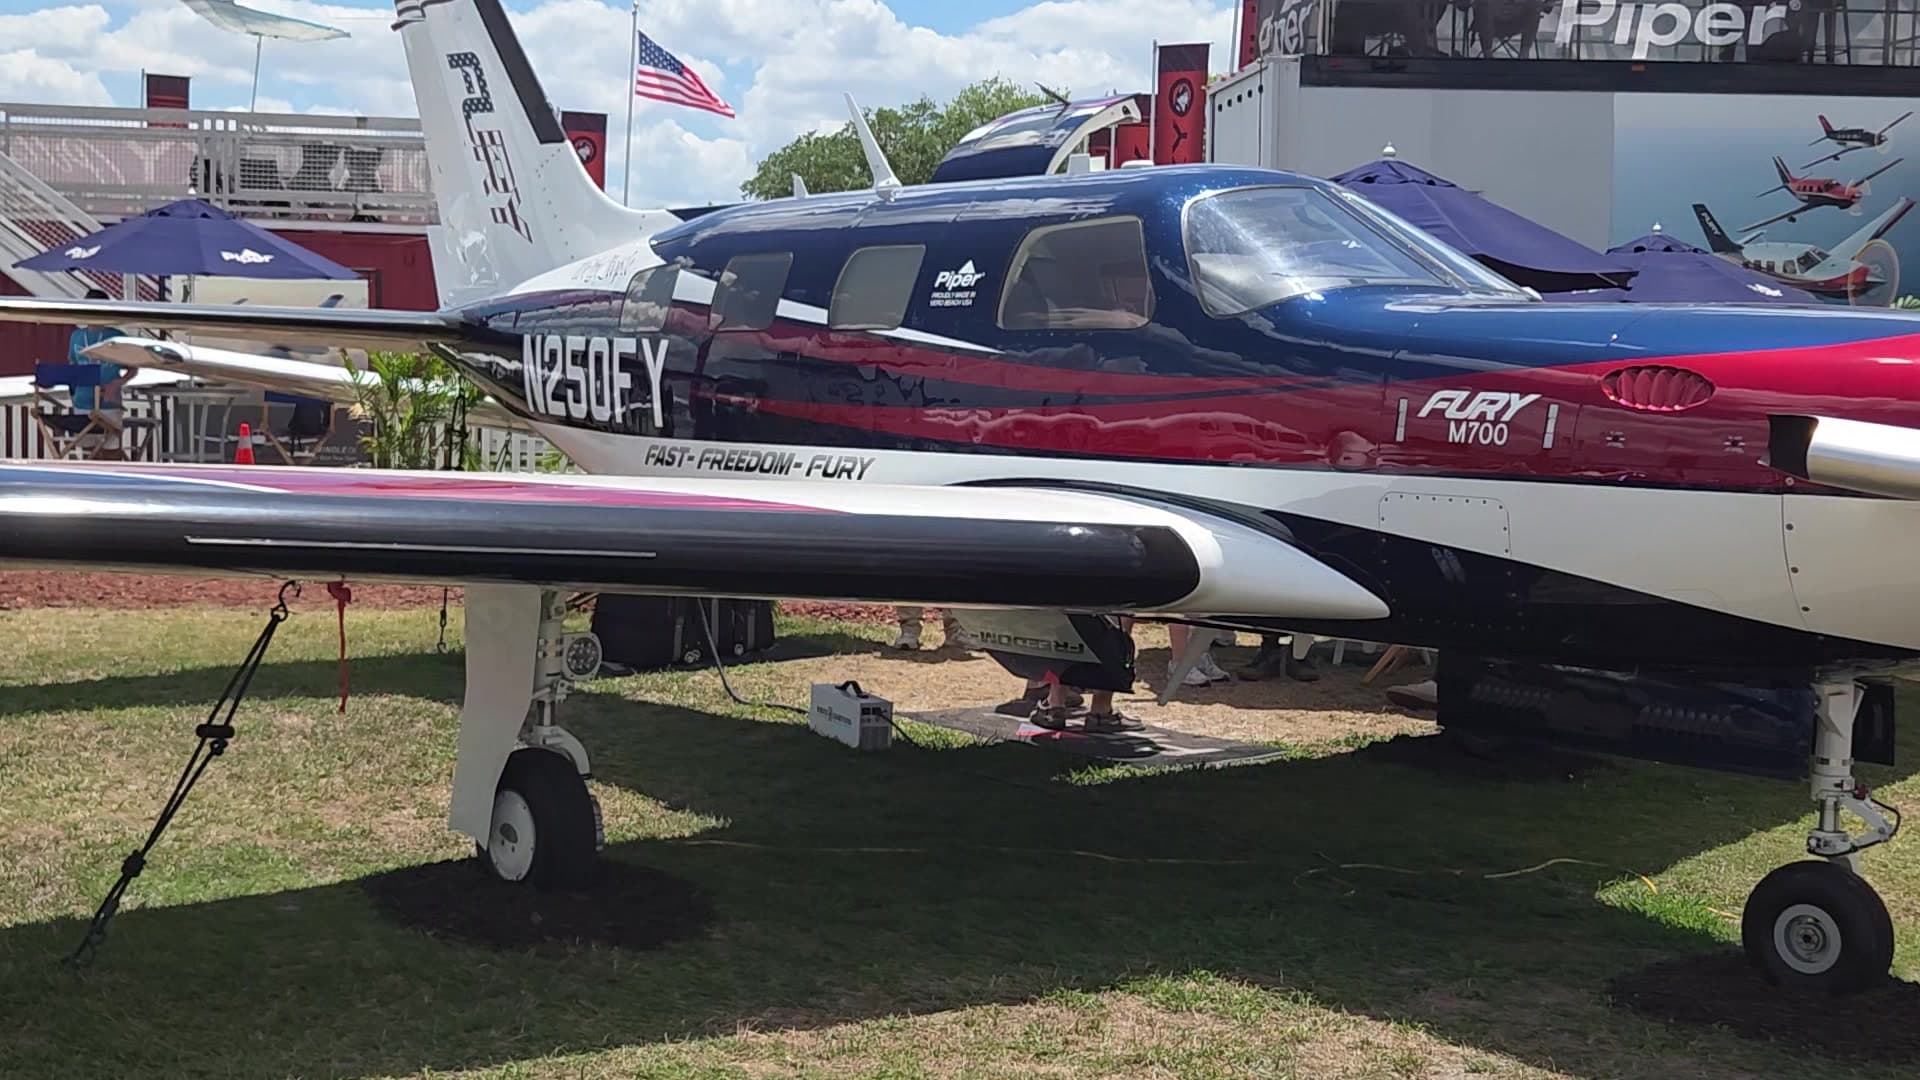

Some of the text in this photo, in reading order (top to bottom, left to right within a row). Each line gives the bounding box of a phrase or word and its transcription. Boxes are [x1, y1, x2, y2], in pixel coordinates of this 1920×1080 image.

[1554, 0, 1787, 59] Piper
[934, 271, 985, 291] Piper
[523, 334, 669, 428] N250FY
[1416, 389, 1542, 422] FURY
[1448, 420, 1508, 446] M700
[805, 454, 876, 481] FURY
